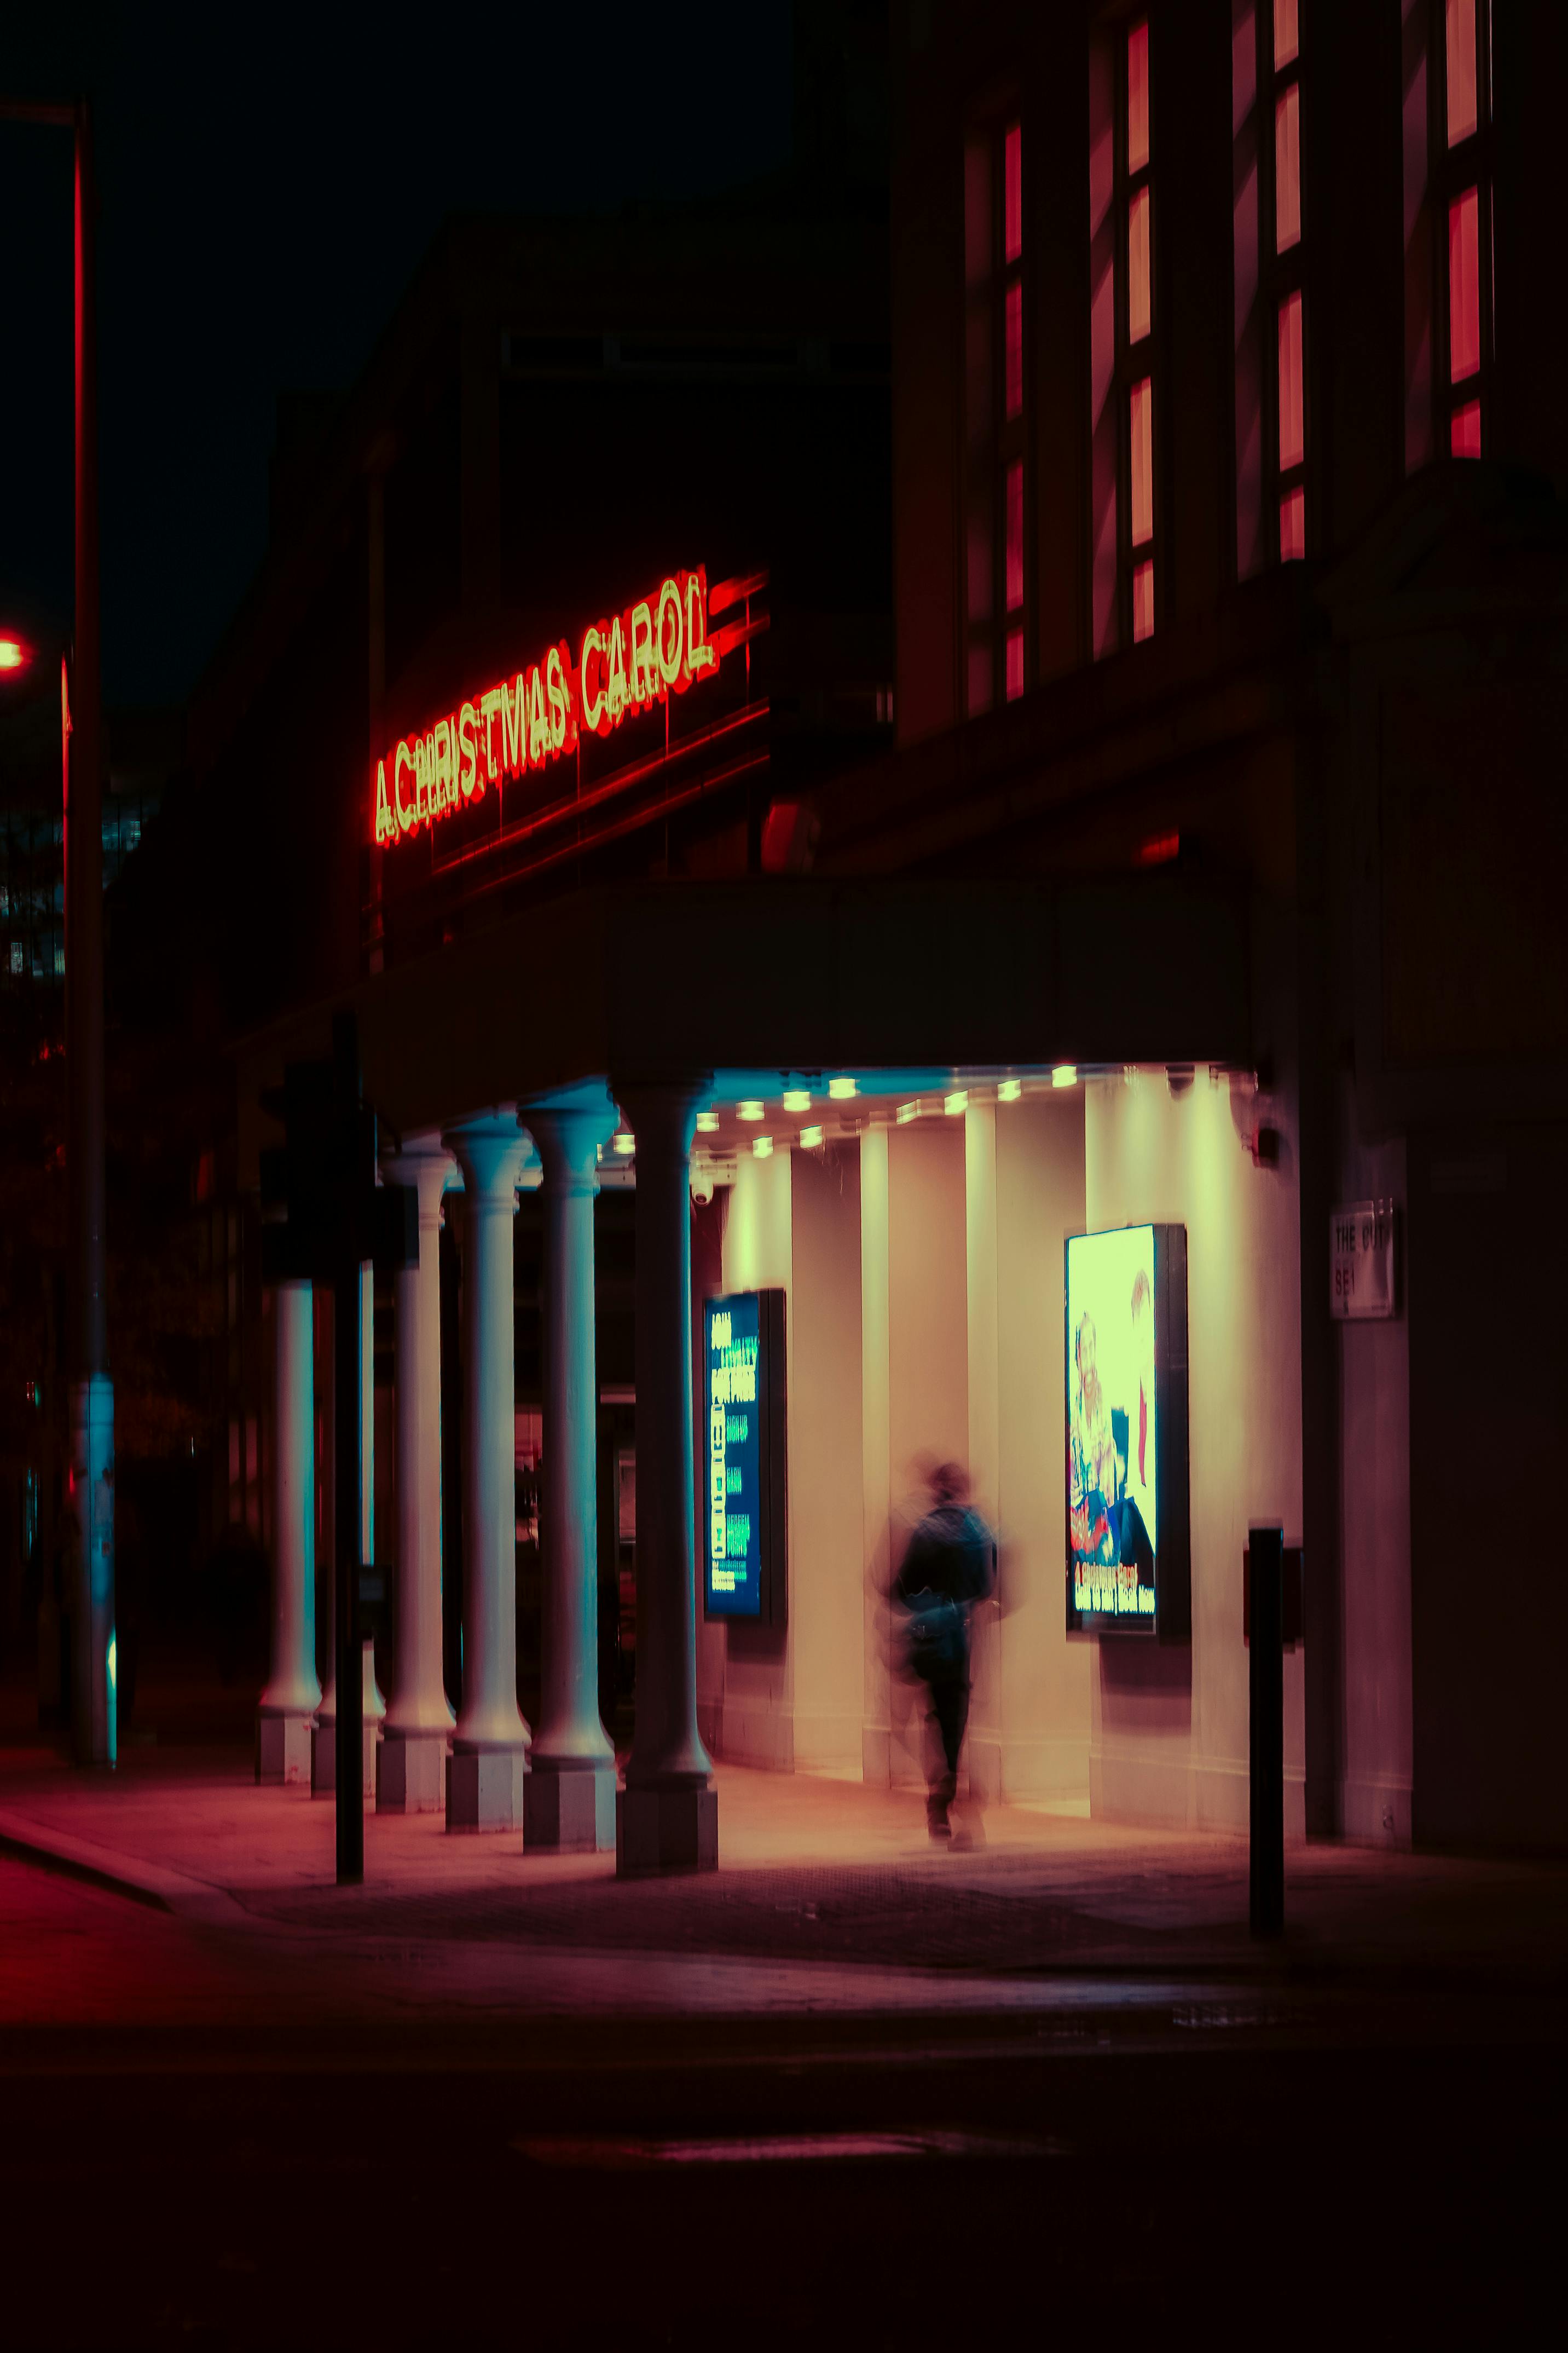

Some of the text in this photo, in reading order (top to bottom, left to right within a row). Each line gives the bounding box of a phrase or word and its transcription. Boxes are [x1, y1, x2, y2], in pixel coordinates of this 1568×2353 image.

[375, 573, 713, 843] A CHRISTMAS CAROL
[1335, 1221, 1385, 1253] THE CUT
[1335, 1264, 1355, 1296] SE1
[726, 1414, 748, 1443] SIGN UP
[1075, 1561, 1138, 1588] A Christmas Carol
[1138, 1584, 1155, 1613] Now
